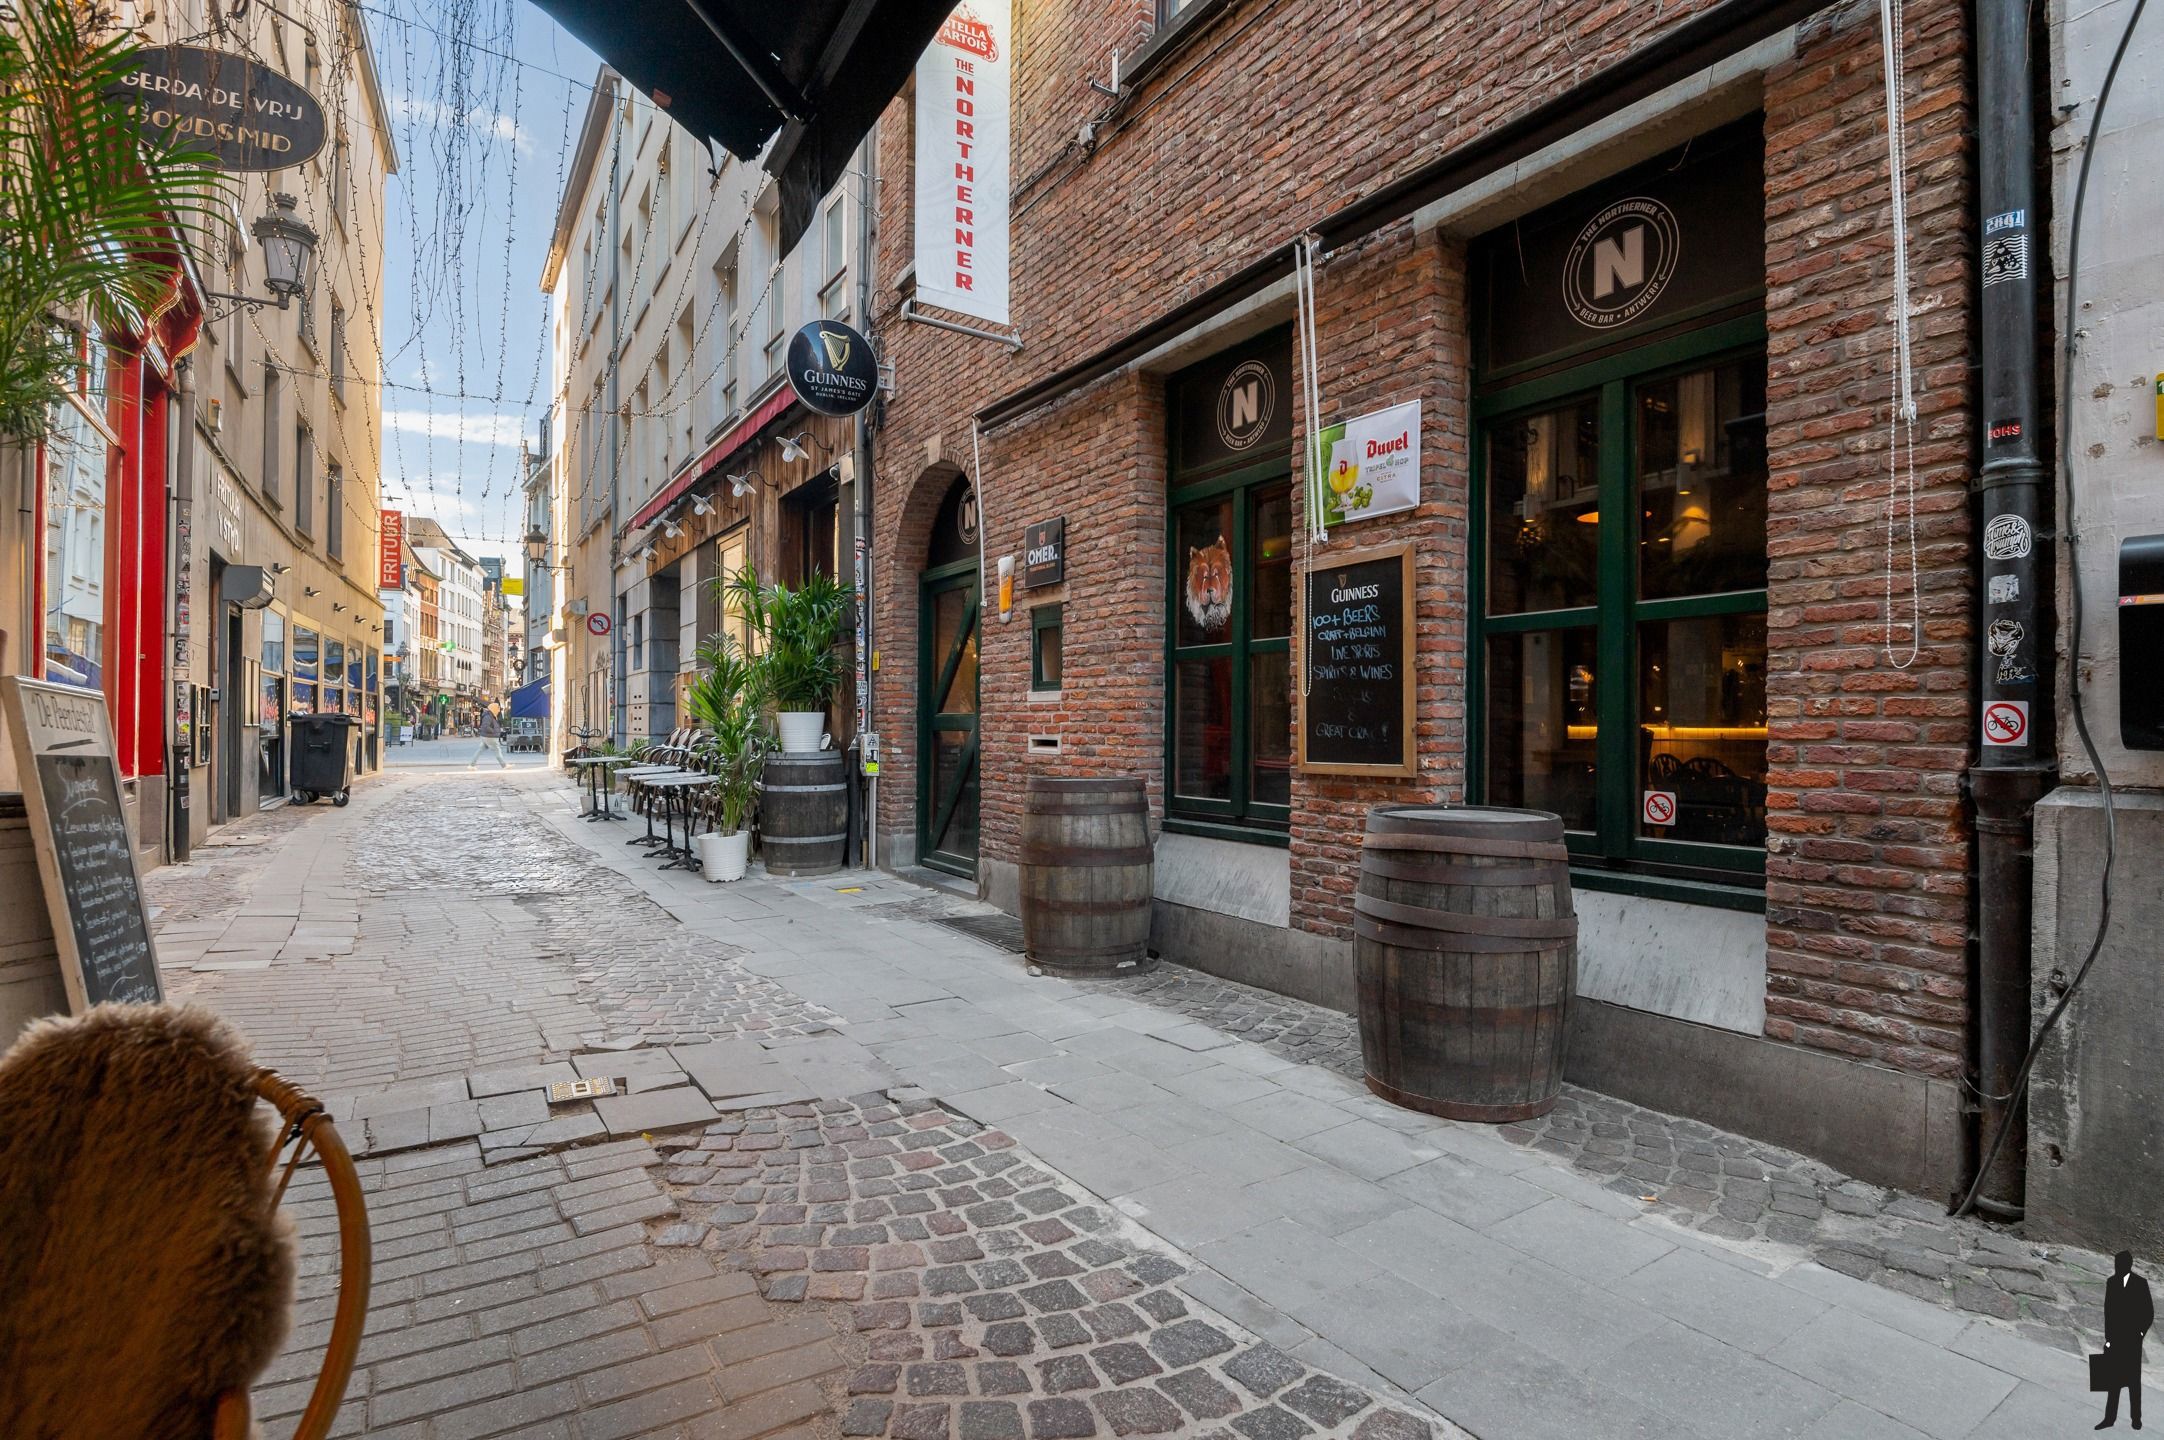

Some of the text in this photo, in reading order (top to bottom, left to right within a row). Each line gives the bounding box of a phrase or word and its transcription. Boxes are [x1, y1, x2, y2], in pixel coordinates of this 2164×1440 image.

[943, 28, 987, 52] ARTOIS
[955, 58, 974, 74] THE
[120, 71, 303, 121] GERDA DE VRIJ
[127, 101, 292, 153] GOUDSMID
[955, 75, 974, 292] NORTHERNER
[1581, 201, 1658, 242] THE NORTHERNER
[1593, 224, 1645, 300] N
[1580, 282, 1659, 323] BEER BAR ANTWERP
[804, 369, 867, 391] GUINNESS
[1232, 380, 1259, 430] N
[1366, 430, 1409, 460] Duvel
[1376, 474, 1396, 482] CITRA
[964, 500, 976, 529] N
[1028, 545, 1058, 566] OMER.
[1331, 584, 1379, 604] GUINNESS
[1343, 604, 1381, 626] BEERS
[1359, 663, 1393, 681] WINES
